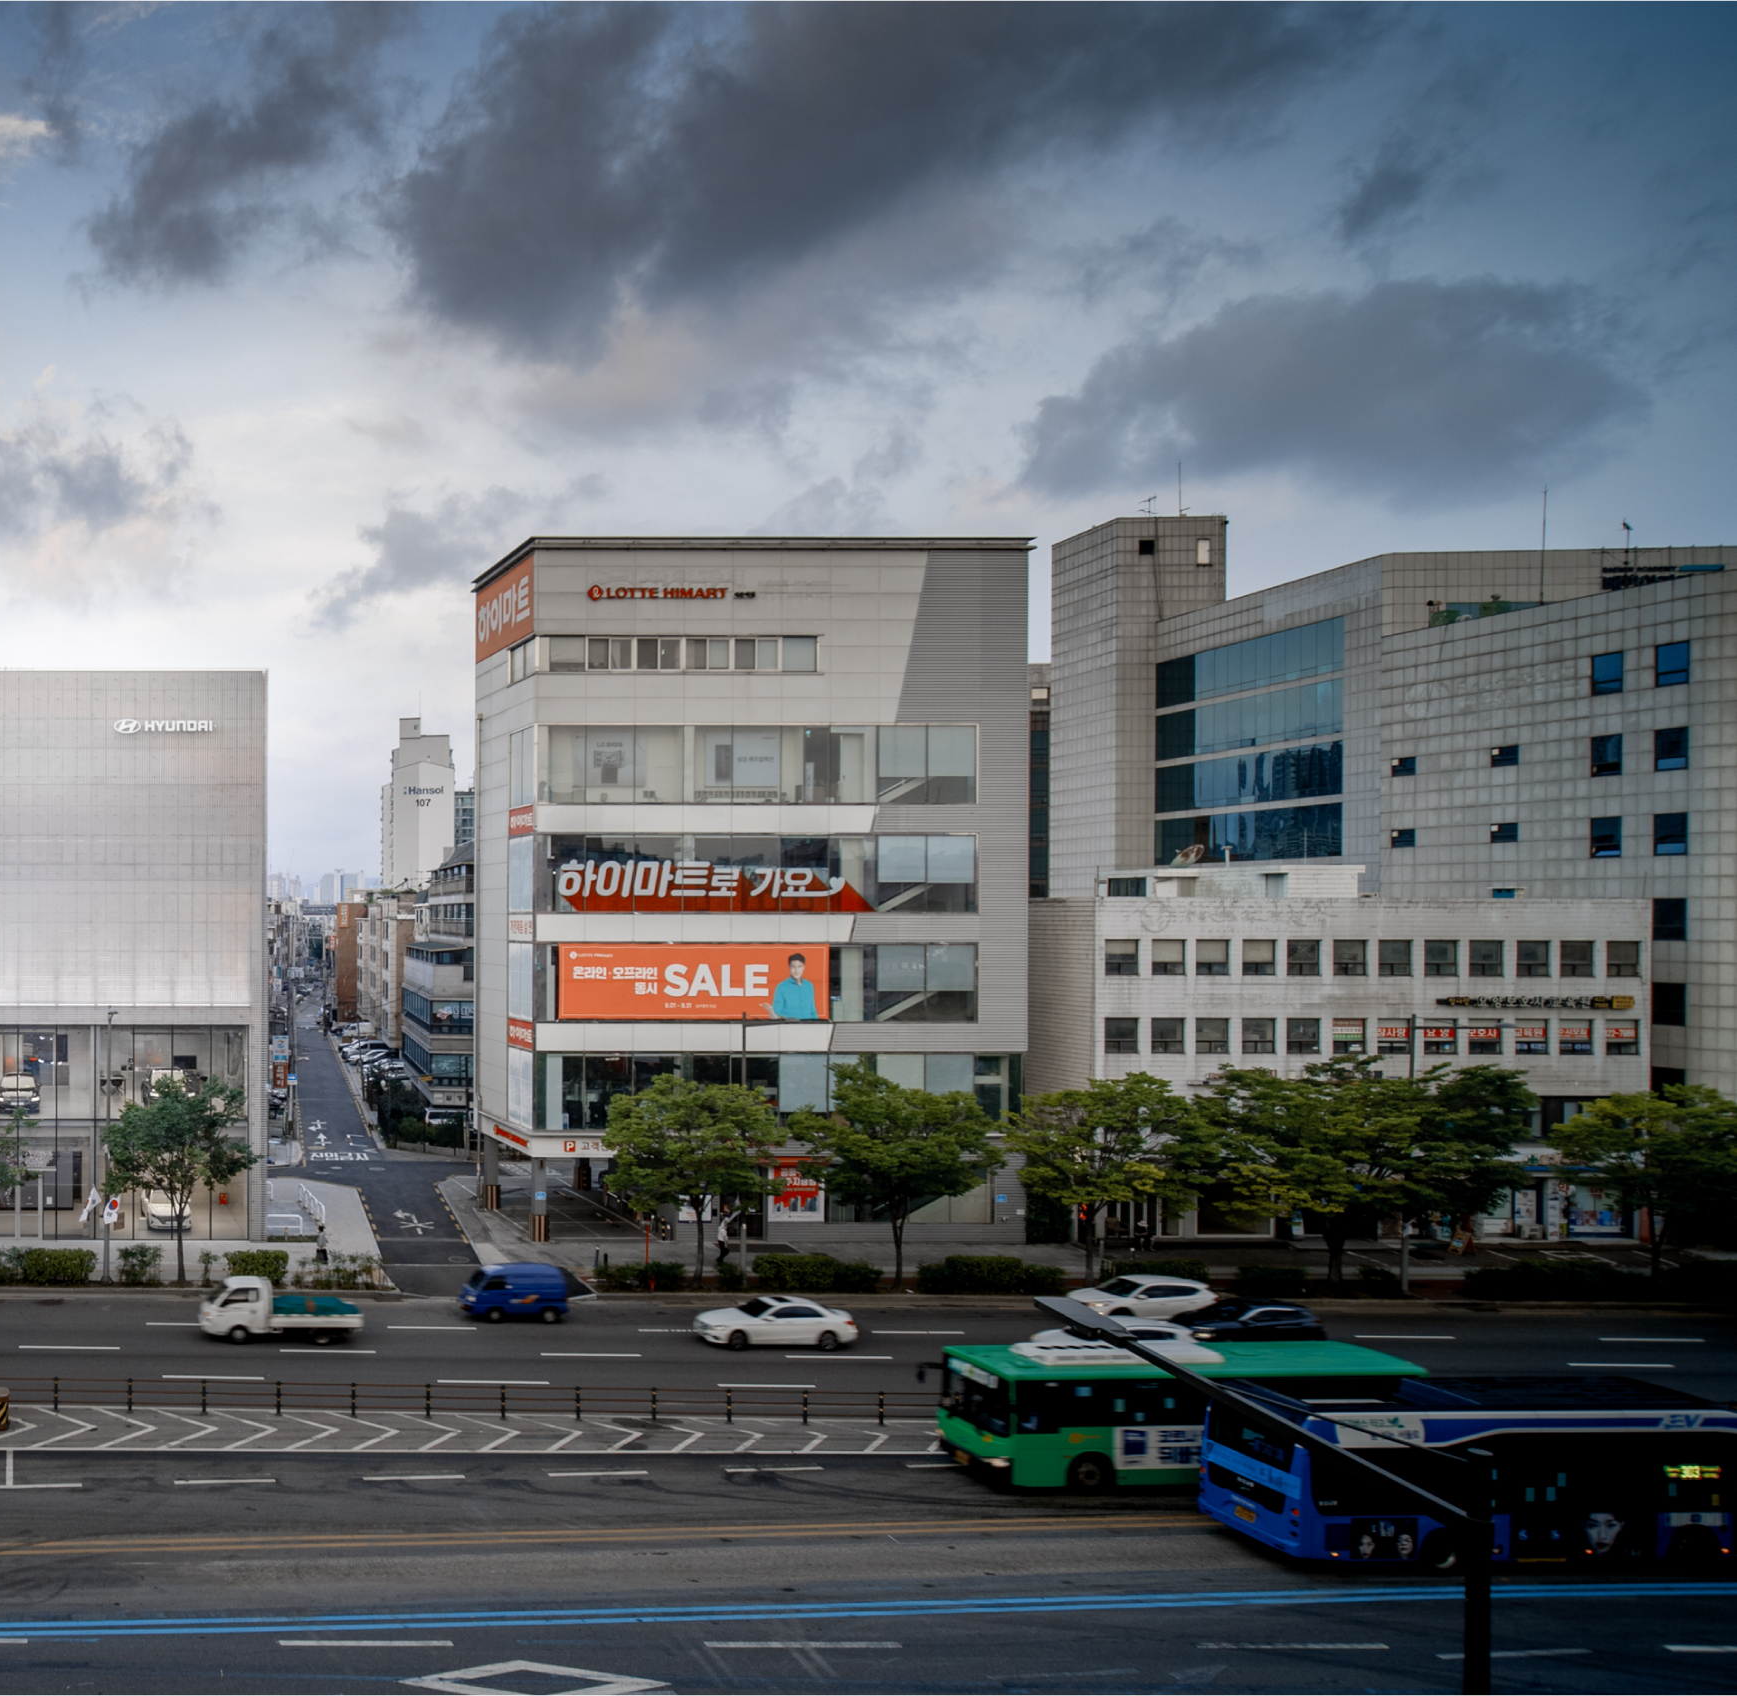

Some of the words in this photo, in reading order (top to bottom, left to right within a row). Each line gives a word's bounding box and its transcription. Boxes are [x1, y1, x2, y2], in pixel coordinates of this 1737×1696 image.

[606, 587, 658, 599] LOTTE
[664, 587, 728, 599] HIMART
[478, 575, 530, 644] 하이마트
[144, 720, 213, 732] HYUNDAI
[408, 786, 444, 795] Hansol
[415, 798, 431, 807] 107
[510, 813, 533, 829] 하이마트
[558, 859, 740, 900] 하이마트로
[750, 865, 828, 900] 가요
[664, 964, 769, 997] SALE
[634, 982, 658, 995] 동시
[509, 1025, 533, 1043] 하이마트
[1427, 1028, 1450, 1038] 요양
[1514, 1028, 1544, 1038] 교육원
